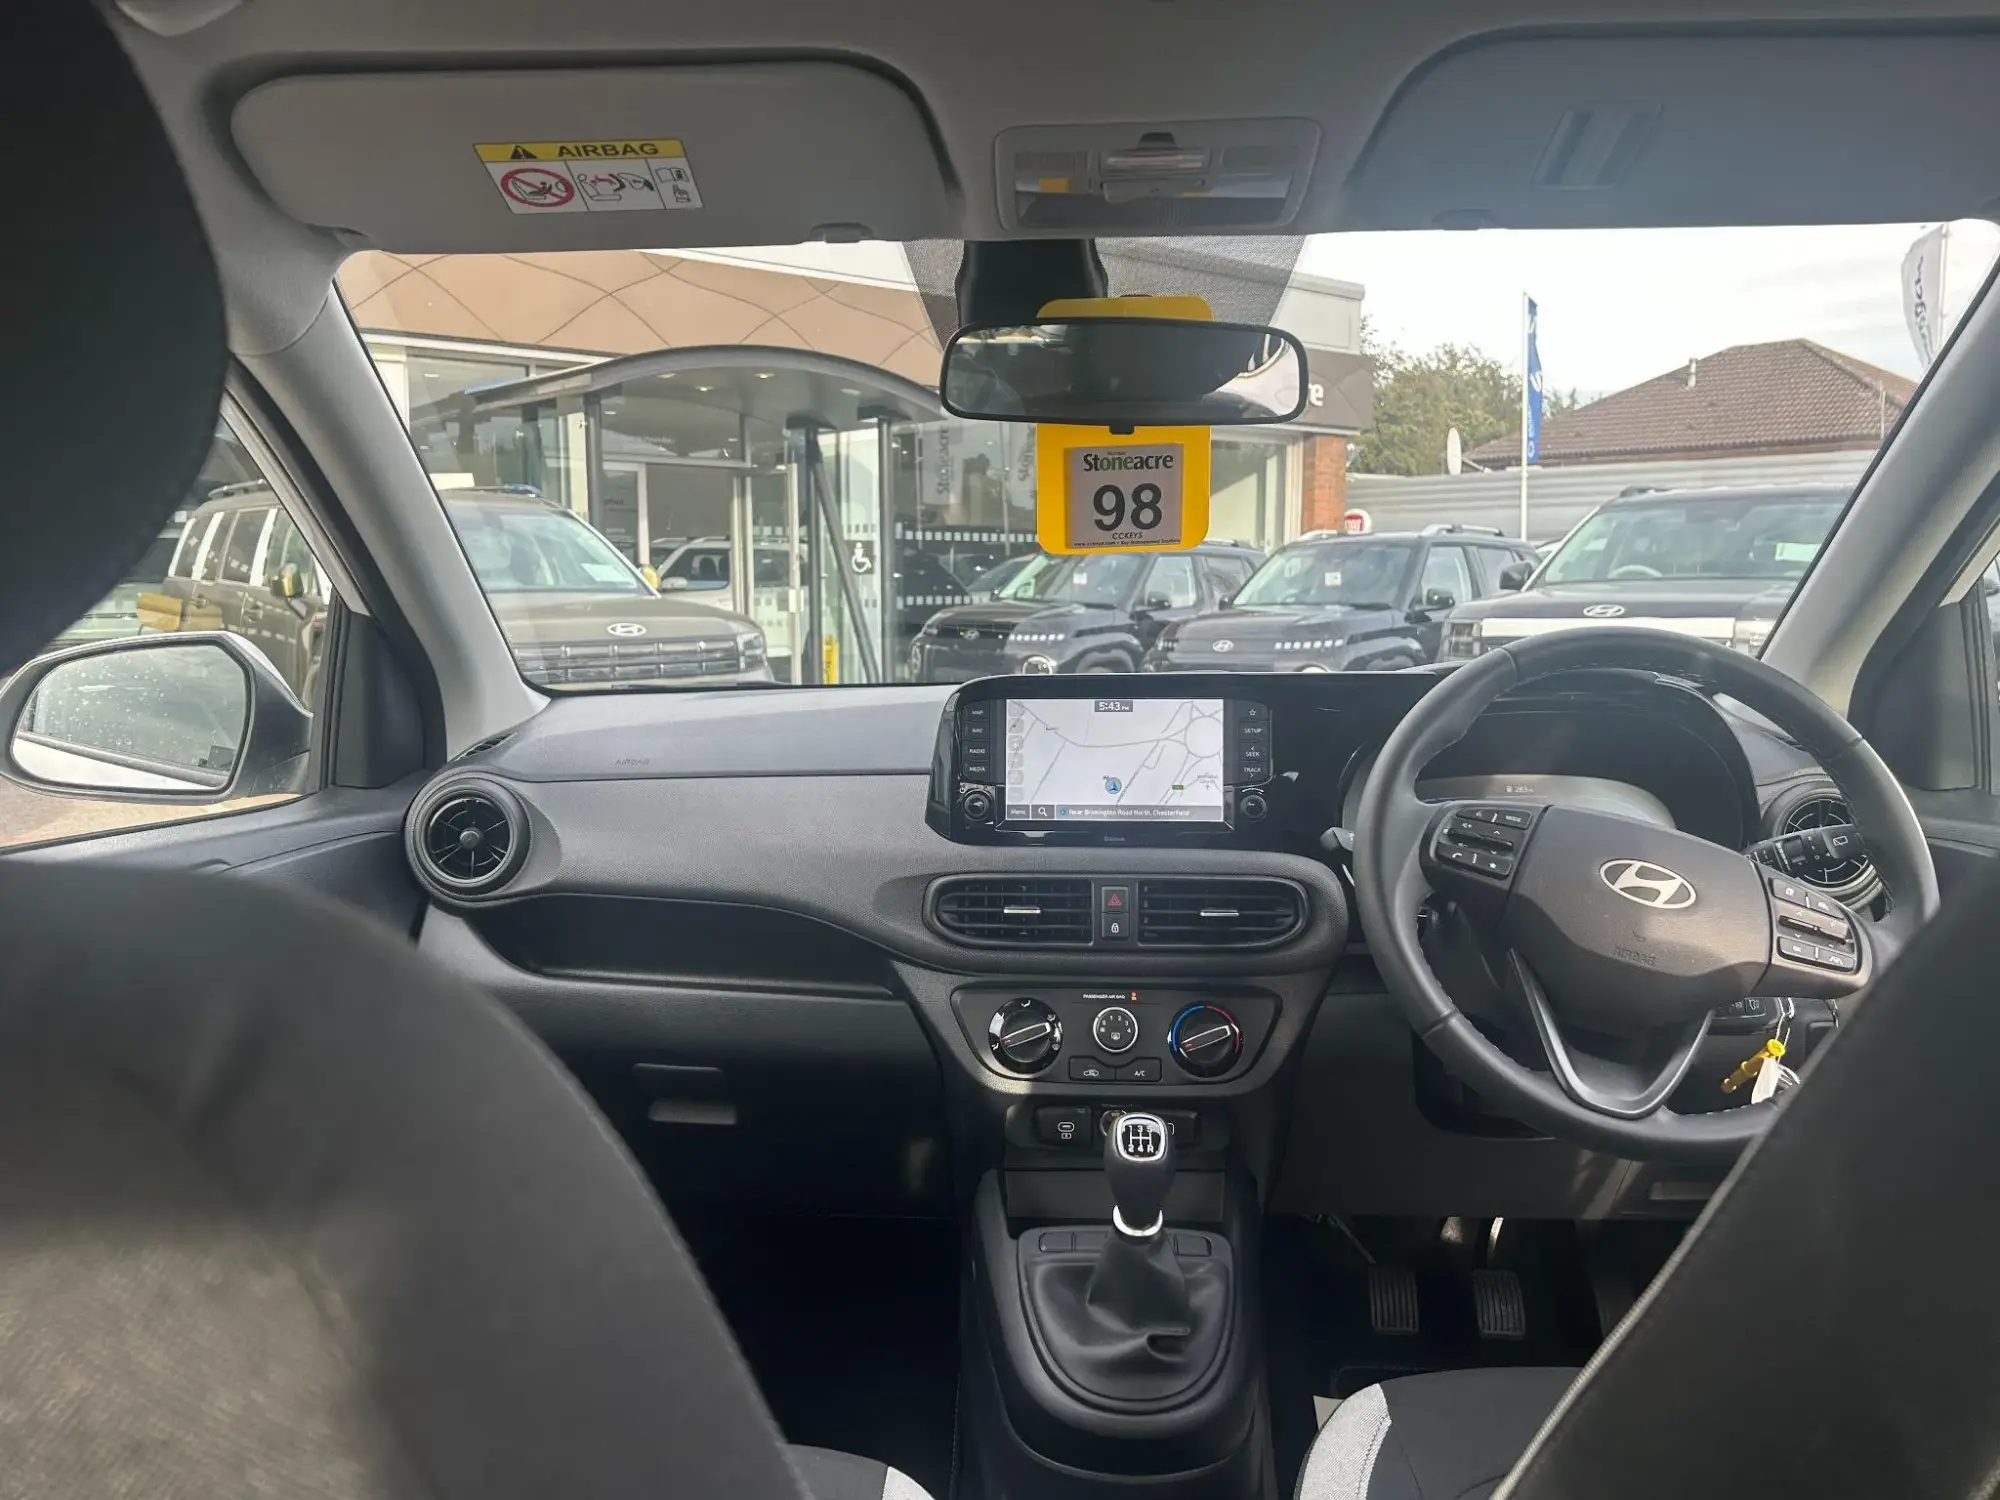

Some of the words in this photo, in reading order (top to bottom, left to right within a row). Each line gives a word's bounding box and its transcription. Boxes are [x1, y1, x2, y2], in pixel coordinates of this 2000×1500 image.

[557, 143, 660, 158] AIRBAG
[1083, 453, 1174, 472] Stoneacre
[1092, 482, 1163, 532] 98
[1111, 531, 1143, 540] CCKEYS
[1099, 701, 1120, 711] 5:43
[1137, 1124, 1143, 1133] 3
[1146, 1124, 1153, 1133] 5
[1128, 1144, 1134, 1153] 2
[1137, 1144, 1144, 1153] 4
[1147, 1144, 1154, 1153] R
